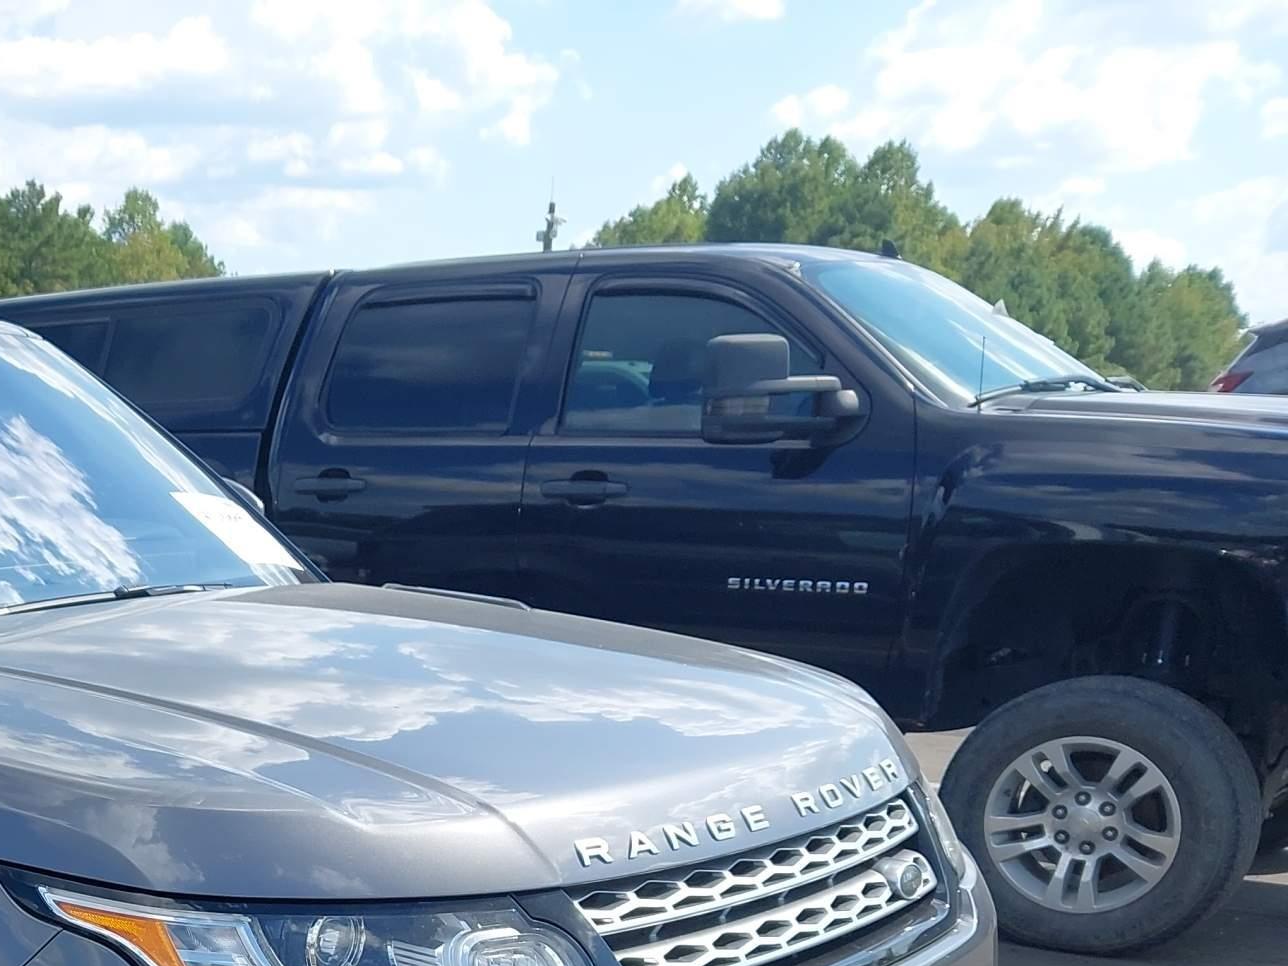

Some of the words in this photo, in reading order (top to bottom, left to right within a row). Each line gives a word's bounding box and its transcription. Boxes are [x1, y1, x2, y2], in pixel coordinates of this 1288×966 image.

[727, 577, 869, 594] SILVERADO
[573, 804, 771, 867] RANGE
[790, 758, 900, 817] ROVER
